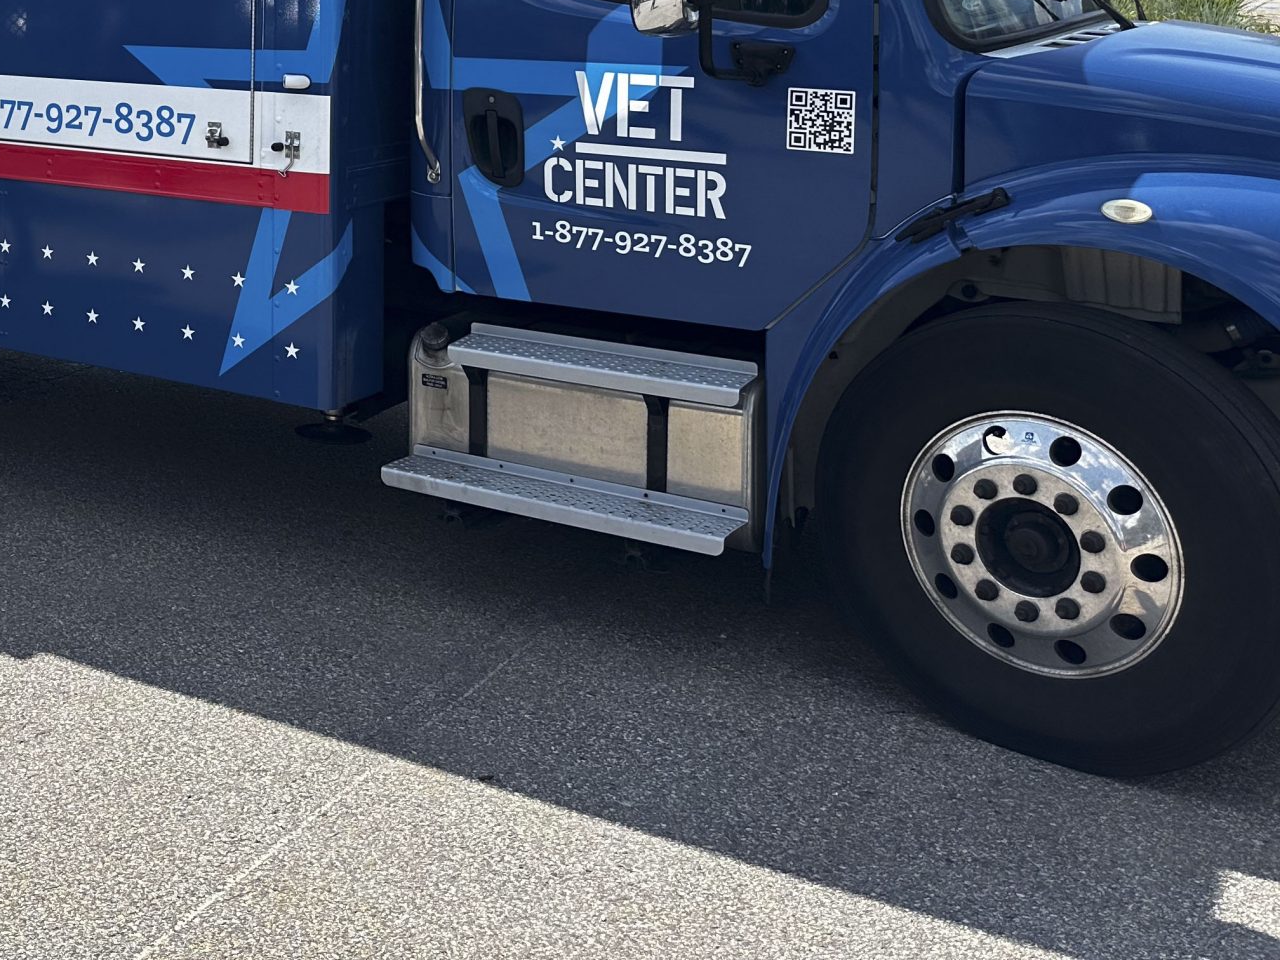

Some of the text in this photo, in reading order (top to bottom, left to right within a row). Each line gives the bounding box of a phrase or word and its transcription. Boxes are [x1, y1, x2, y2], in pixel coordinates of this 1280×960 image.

[575, 71, 695, 141] VET
[544, 157, 727, 219] CENTER
[531, 220, 752, 268] 1-877-927-8387
